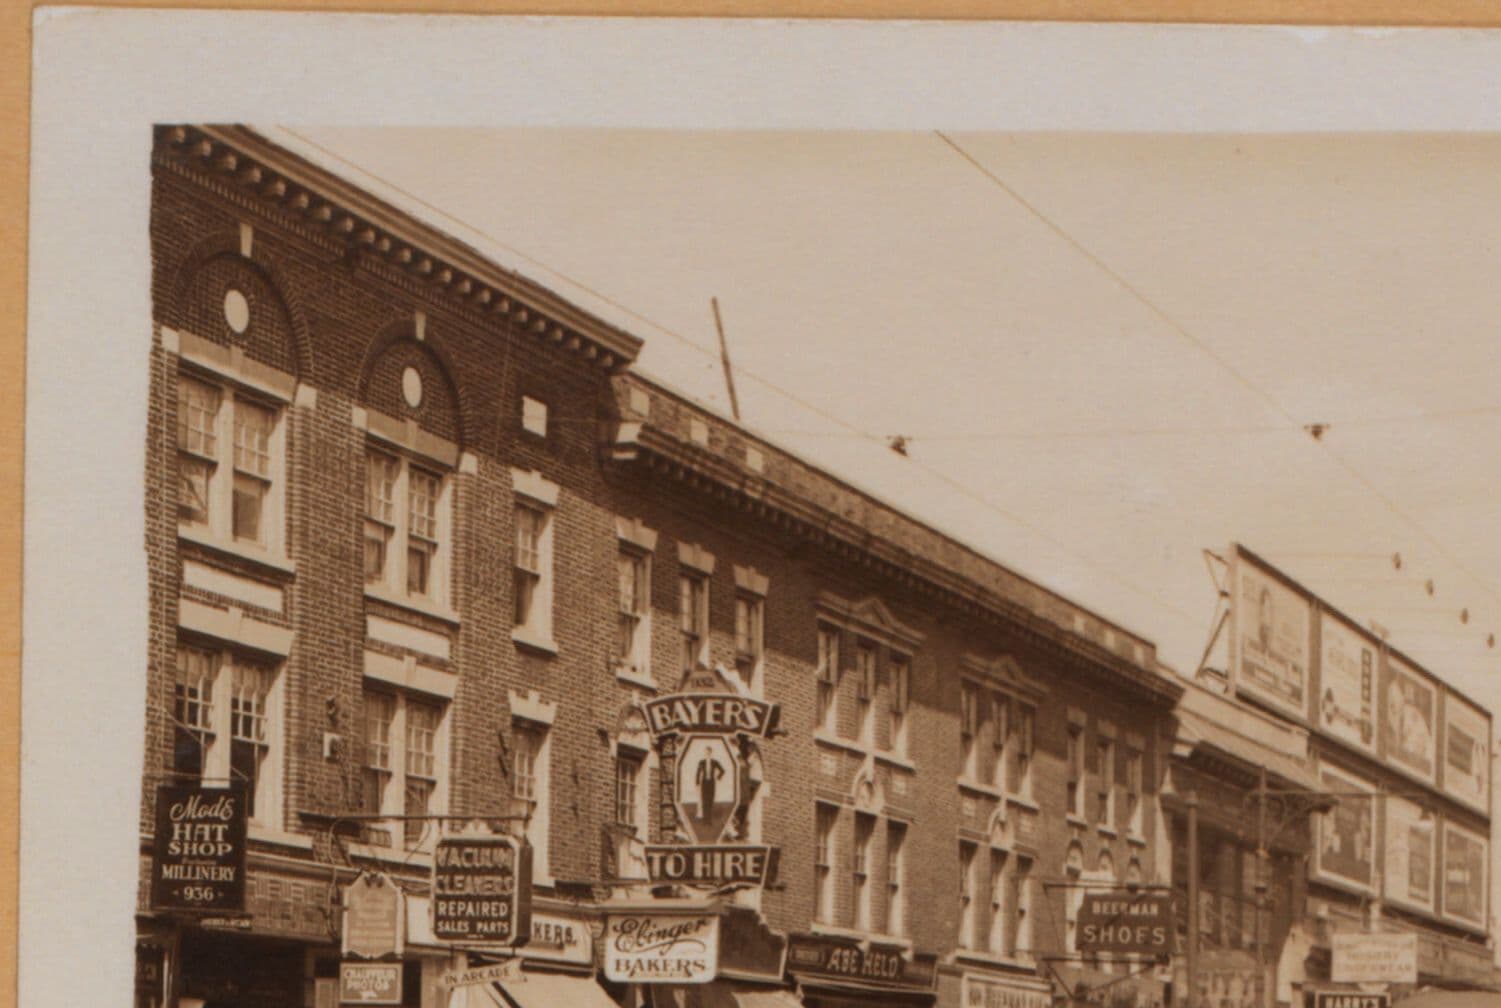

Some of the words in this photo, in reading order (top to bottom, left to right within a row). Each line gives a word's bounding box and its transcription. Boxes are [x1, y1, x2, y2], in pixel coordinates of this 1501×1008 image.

[172, 823, 229, 842] HAT
[168, 841, 233, 856] SHOP
[437, 848, 514, 867] VACUUM
[162, 864, 236, 881] MILLINERY
[649, 852, 686, 878] TO
[693, 852, 761, 878] HIRE
[183, 886, 214, 900] 936
[438, 902, 508, 917] REPAIRED
[437, 921, 470, 933] SALES
[477, 922, 509, 933] PARTS
[533, 922, 577, 946] KERS.
[1083, 924, 1166, 945] SHOES
[615, 958, 706, 978] BAKERS
[827, 947, 858, 973] ABE
[445, 974, 458, 985] IN
[463, 965, 511, 982] ARCADE
